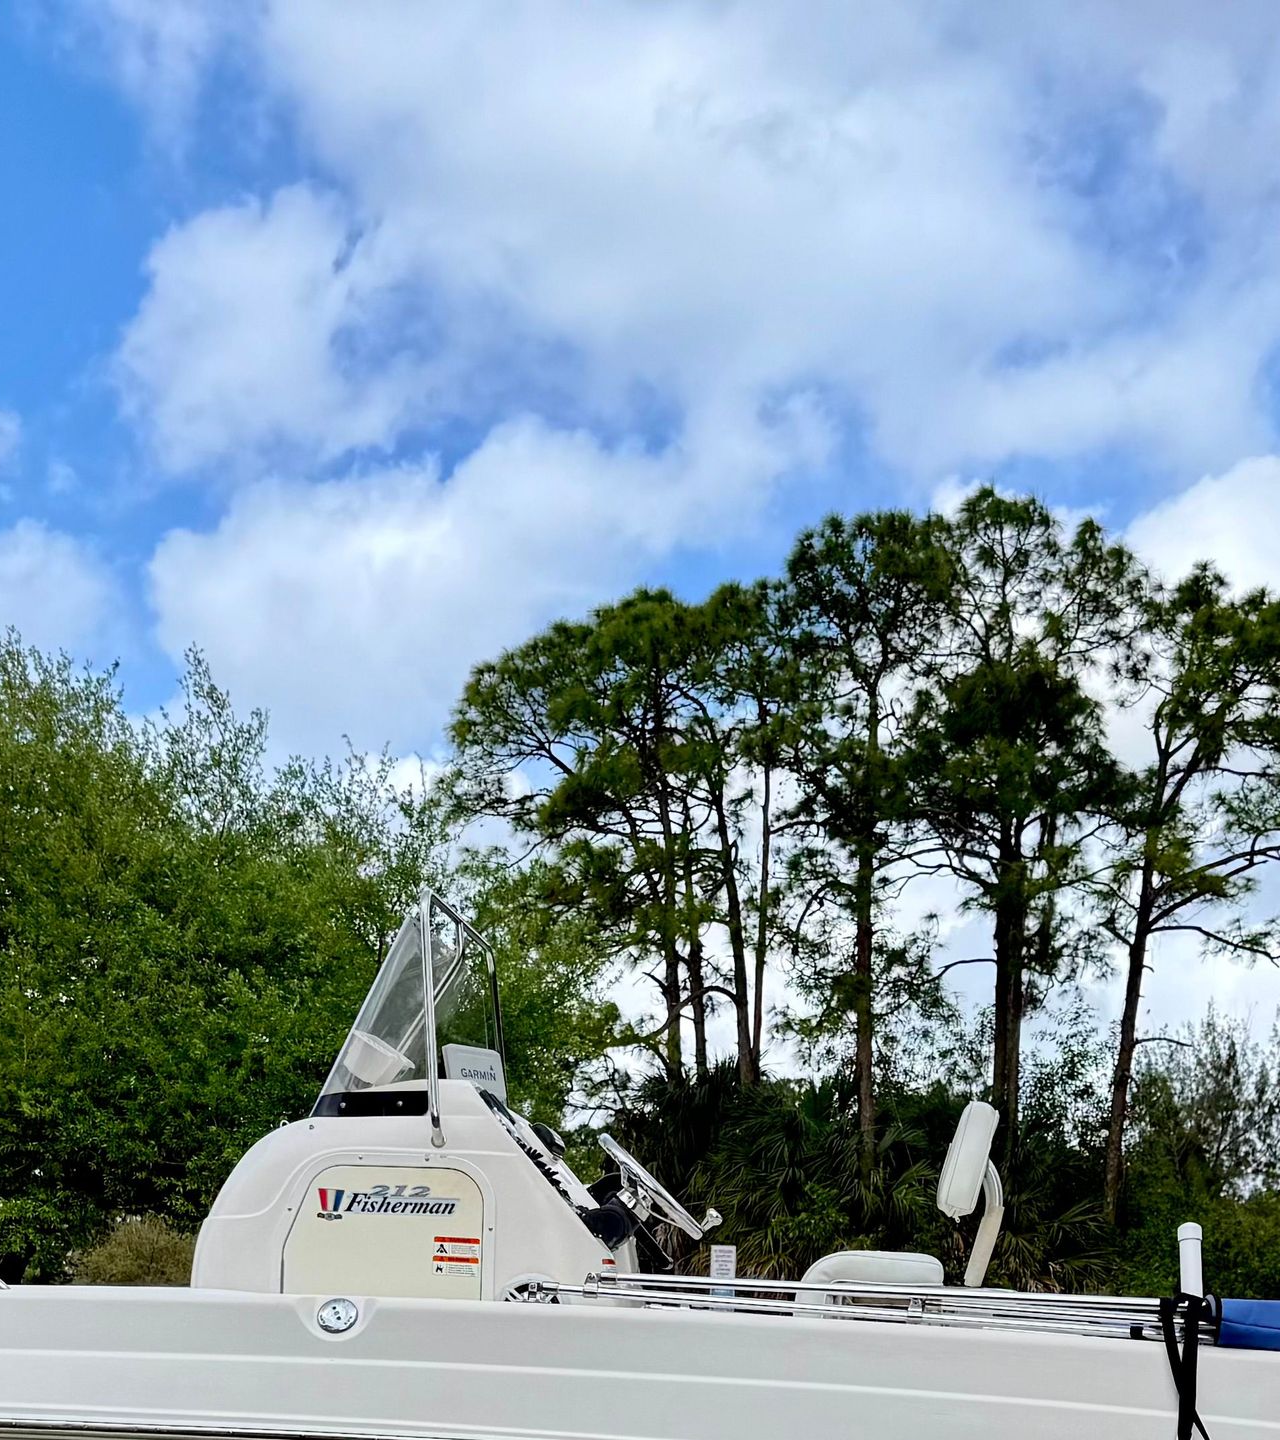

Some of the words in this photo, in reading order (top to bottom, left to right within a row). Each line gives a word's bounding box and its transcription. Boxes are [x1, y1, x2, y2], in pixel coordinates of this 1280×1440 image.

[460, 1067, 496, 1081] GARMIN
[370, 1184, 431, 1198] 212
[344, 1192, 456, 1215] Fisherman
